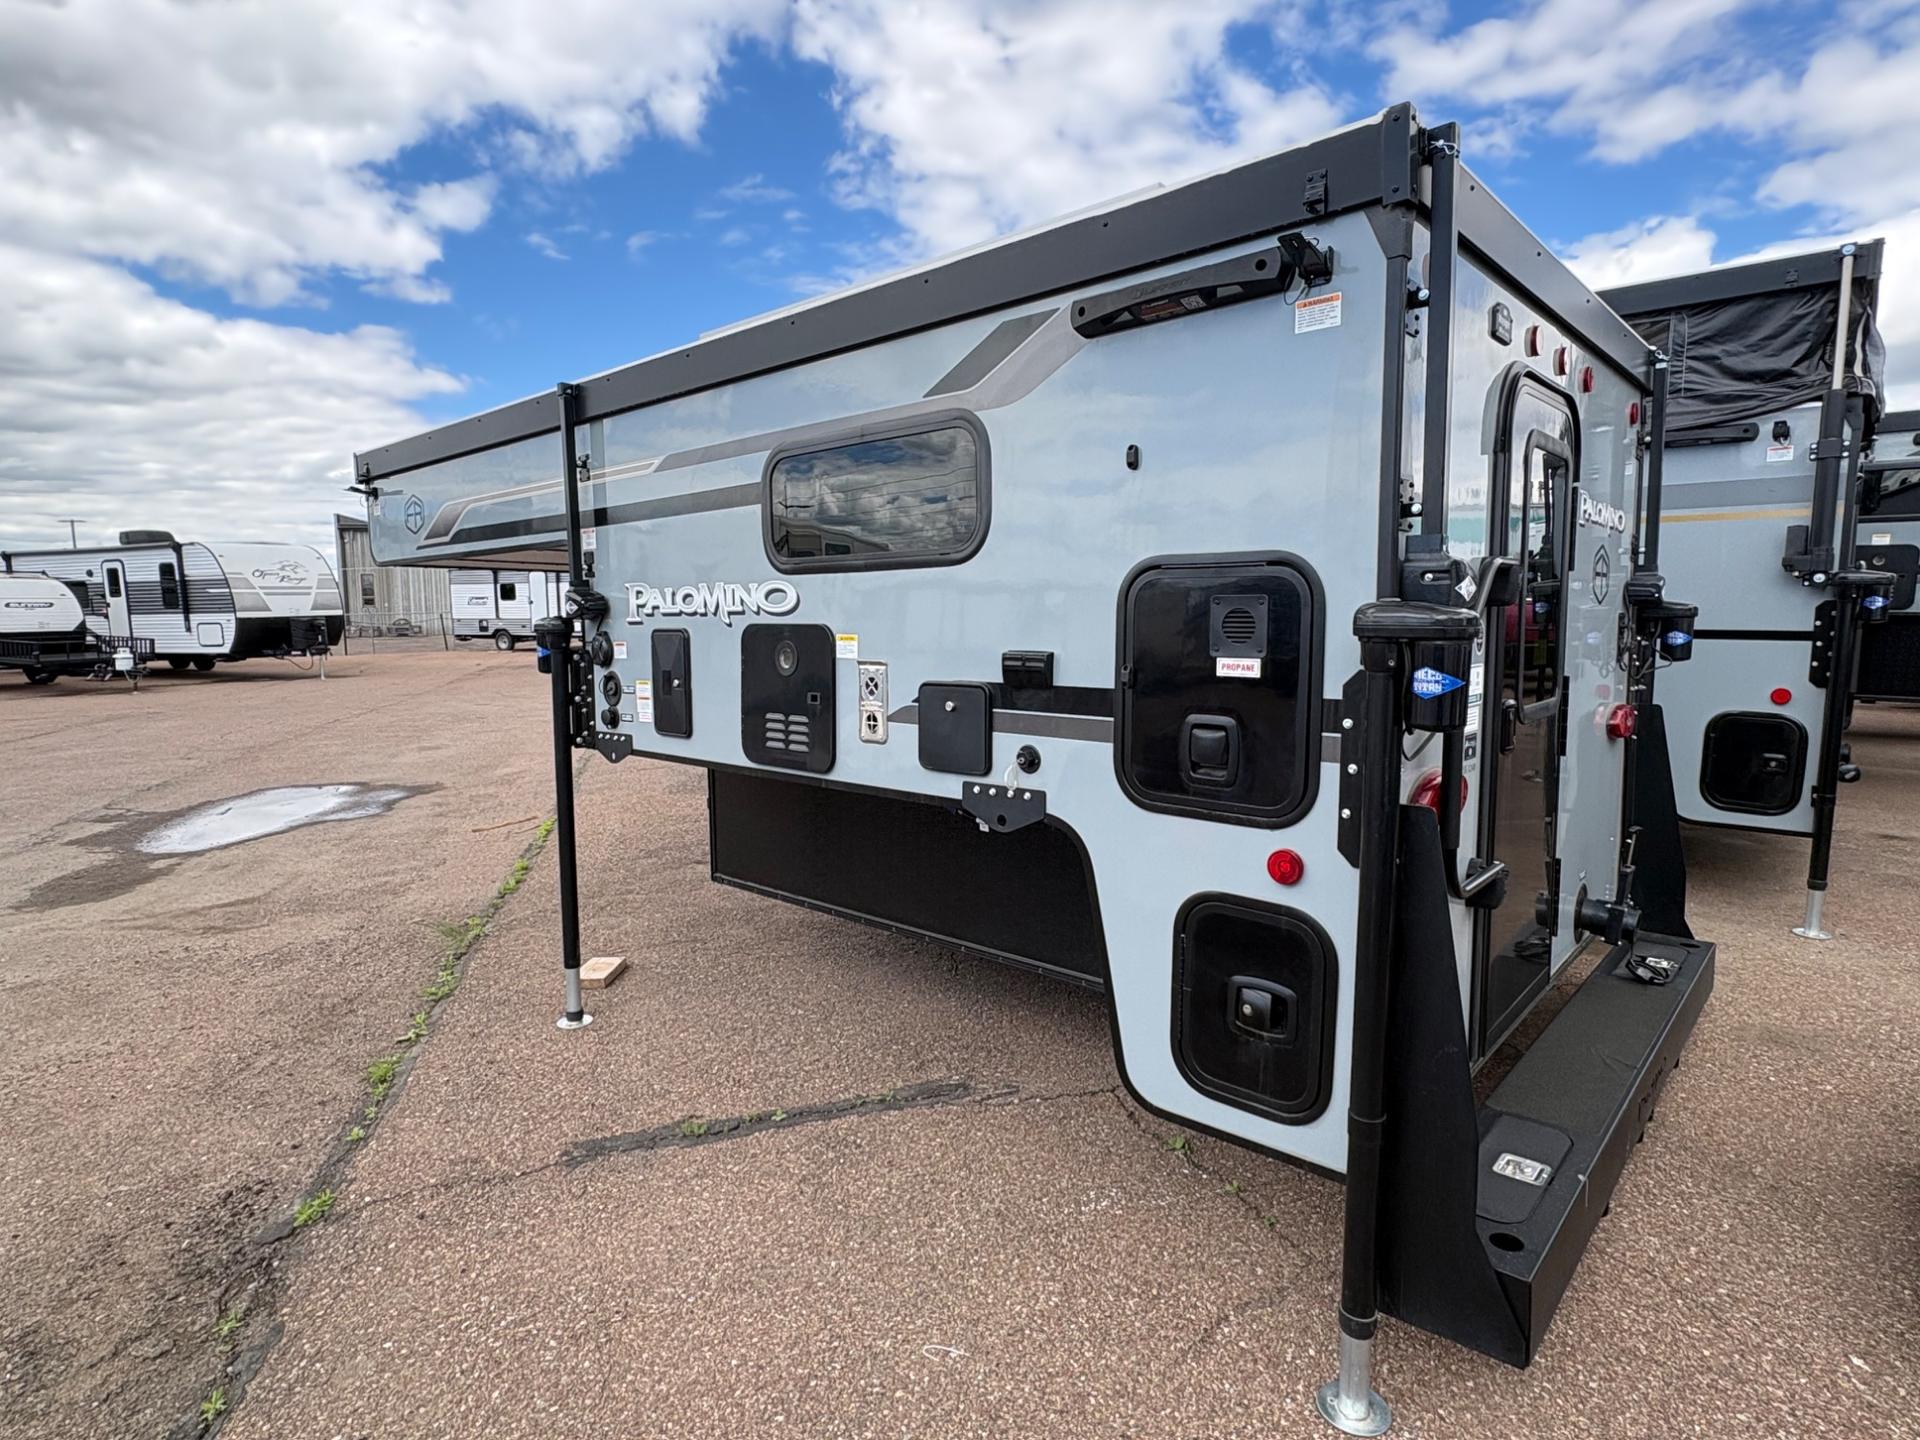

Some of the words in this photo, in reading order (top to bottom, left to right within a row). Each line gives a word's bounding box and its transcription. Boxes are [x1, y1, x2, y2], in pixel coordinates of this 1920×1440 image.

[1578, 489, 1625, 536] PALOMINO
[252, 568, 280, 579] Open
[624, 580, 799, 626] PALOMINO
[1221, 662, 1256, 673] PROPANE
